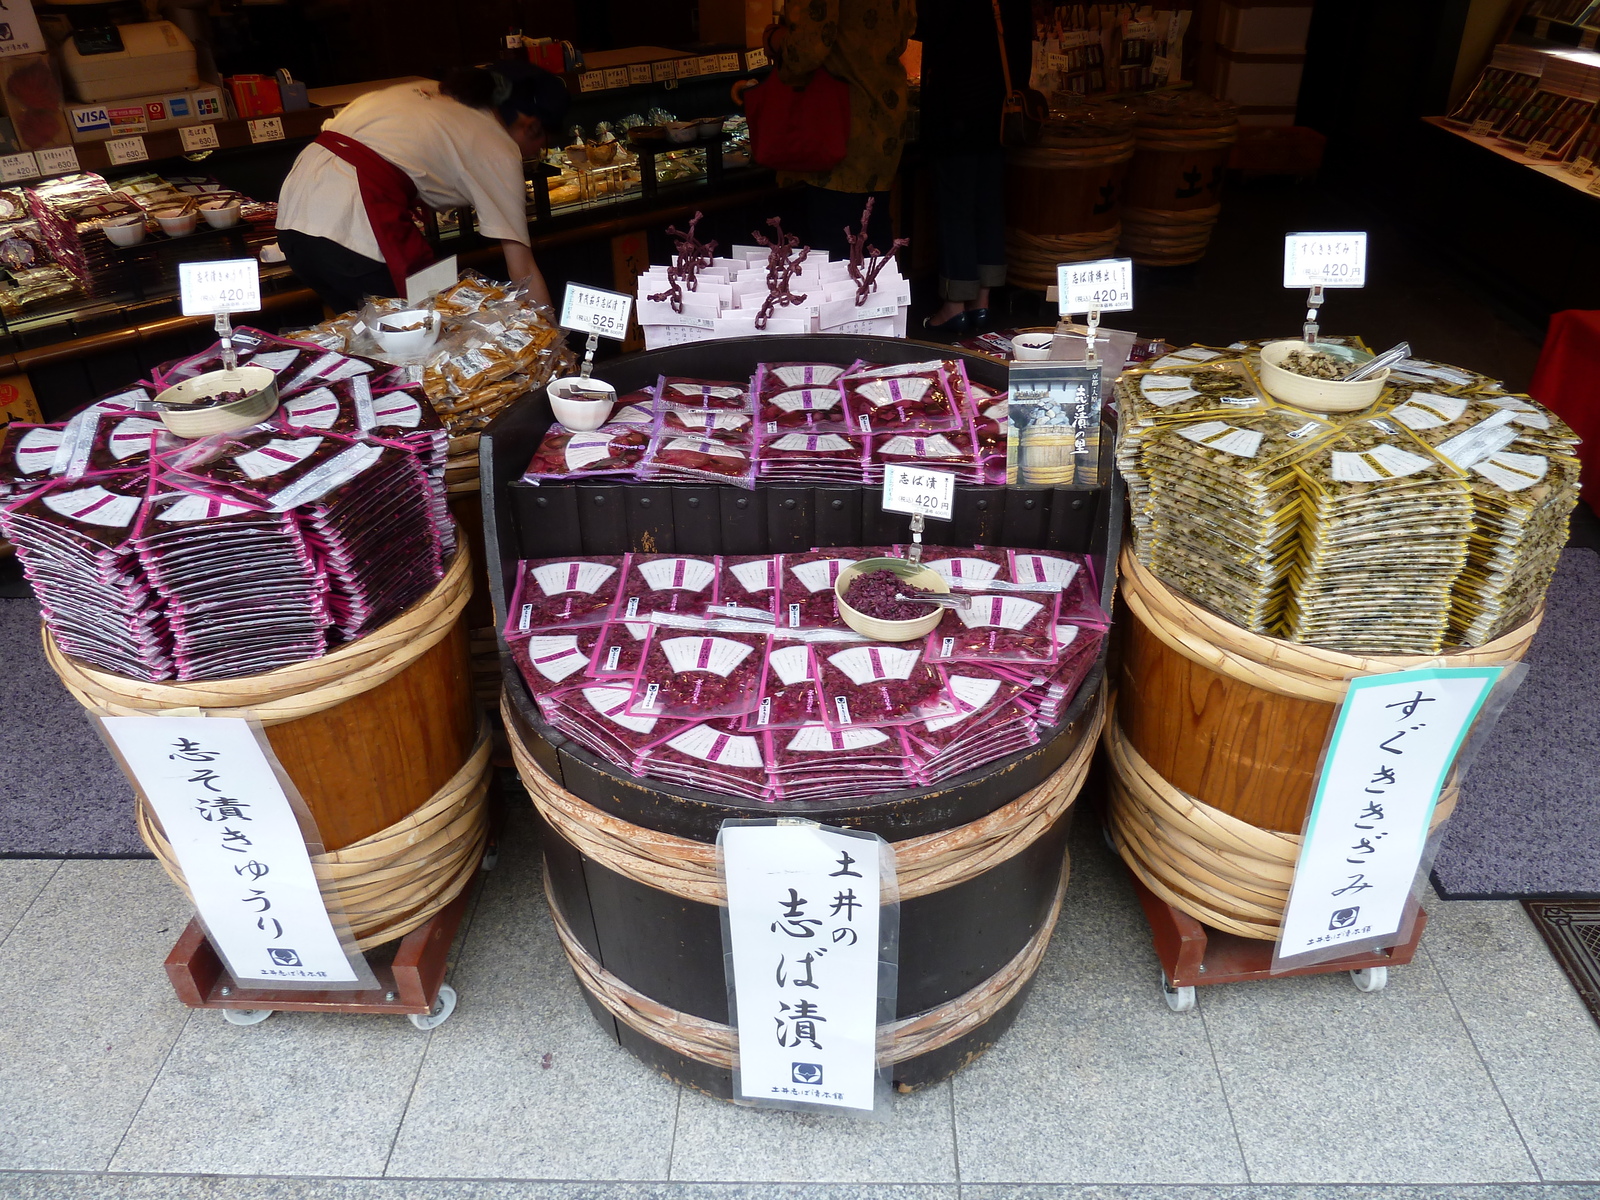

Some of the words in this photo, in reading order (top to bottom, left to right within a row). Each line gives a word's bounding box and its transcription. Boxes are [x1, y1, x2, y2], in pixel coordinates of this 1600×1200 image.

[76, 110, 108, 124] VISA
[899, 472, 938, 490] 志ば漬
[169, 737, 284, 940] 志そ漬きゅうり
[1331, 690, 1437, 897] すぐききざみ
[828, 850, 863, 946] 土井の
[770, 887, 828, 1050] 志ば漬
